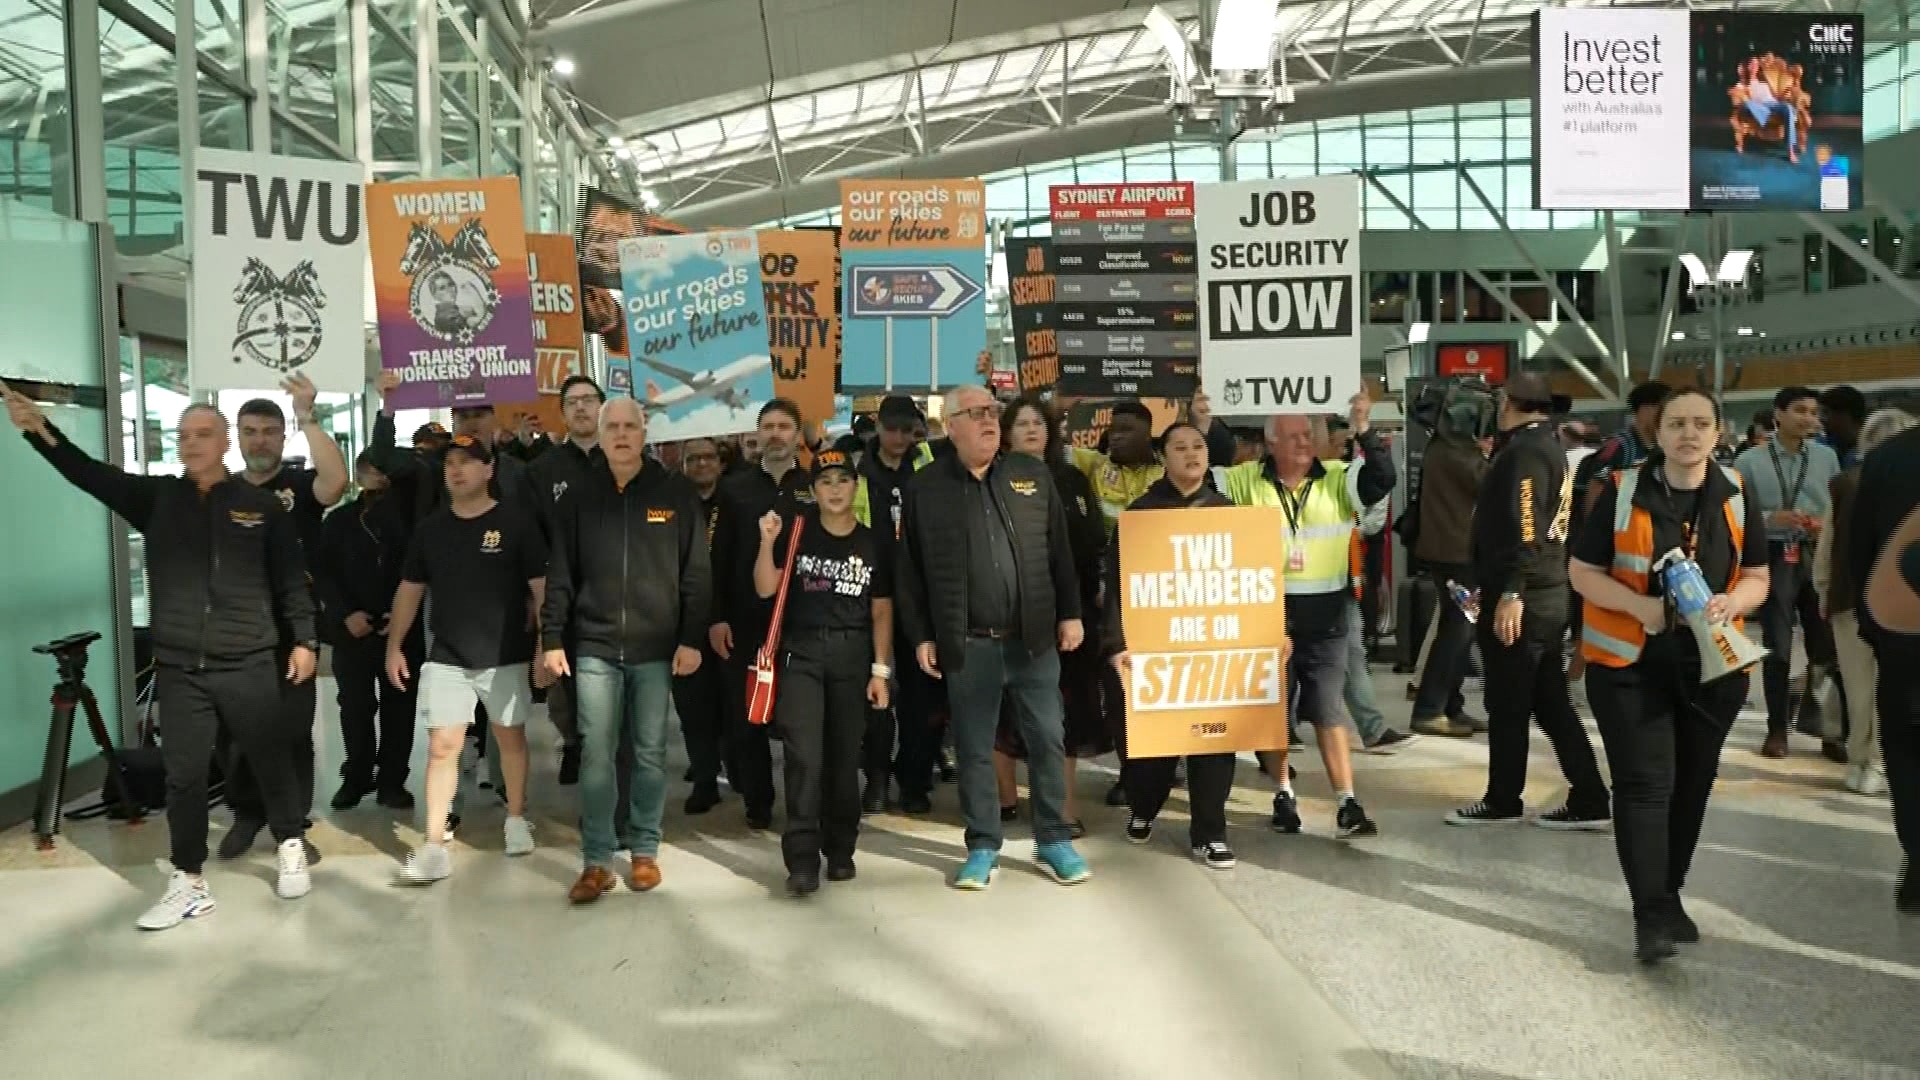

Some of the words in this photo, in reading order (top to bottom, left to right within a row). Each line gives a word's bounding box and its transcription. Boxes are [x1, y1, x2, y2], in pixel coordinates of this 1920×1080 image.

[1564, 31, 1661, 63] Invest
[1564, 63, 1664, 95] better
[1562, 101, 1592, 115] with
[1580, 119, 1637, 135] platform
[197, 170, 360, 245] TWU
[393, 191, 486, 216] WOMEN
[849, 189, 884, 205] our
[889, 185, 949, 204] roads
[1058, 188, 1117, 204] SYDNEY
[1120, 187, 1186, 203] AIRPORT
[1239, 190, 1316, 228] JOB
[849, 207, 885, 221] our
[890, 204, 942, 221] skies
[1055, 210, 1080, 219] FLIGHT
[848, 228, 881, 242] our
[888, 215, 950, 246] future
[759, 252, 799, 277] OB
[1026, 246, 1044, 272] JOB
[1099, 260, 1149, 270] Classification
[1106, 251, 1142, 261] Improved
[1211, 239, 1349, 270] SECURITY
[531, 283, 574, 314] ERS
[628, 288, 671, 313] our
[676, 266, 749, 301] roads
[1012, 275, 1056, 305] SECURIT
[634, 307, 677, 333] our
[682, 290, 746, 320] skies
[1097, 316, 1155, 326] Superannuation
[1219, 280, 1344, 334] NOW
[644, 332, 682, 355] our
[688, 311, 760, 349] future
[409, 345, 508, 367] TRANSPORT
[480, 359, 531, 378] UNION
[1245, 376, 1332, 406] TWU
[1169, 532, 1233, 571] TWU
[834, 581, 862, 598] 2020
[1129, 566, 1276, 609] MEMBERS
[1169, 616, 1206, 642] ARE
[1212, 614, 1240, 641] ON
[1138, 652, 1274, 706] STRIKE
[1201, 722, 1227, 734] TWU
